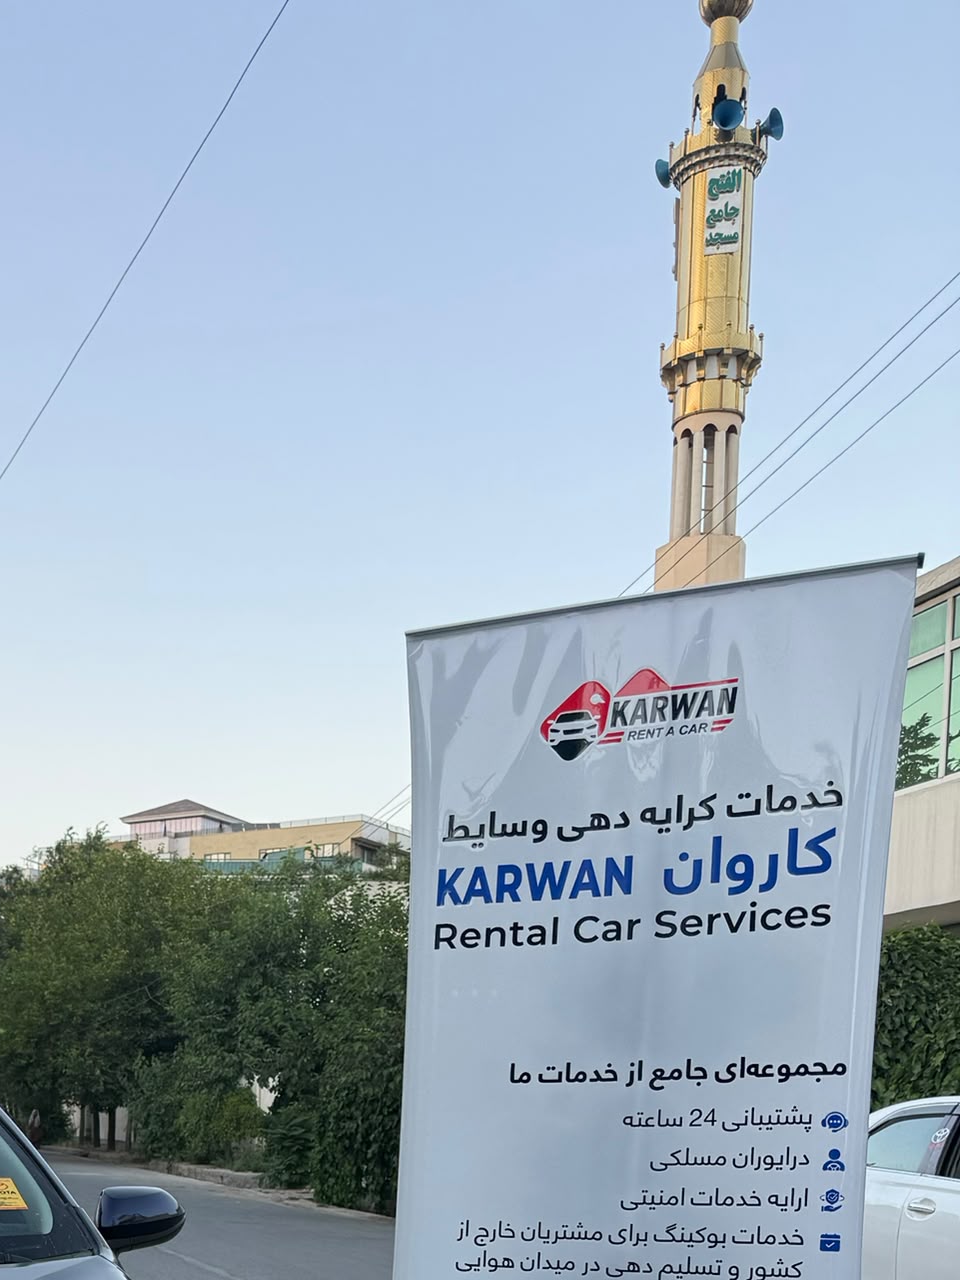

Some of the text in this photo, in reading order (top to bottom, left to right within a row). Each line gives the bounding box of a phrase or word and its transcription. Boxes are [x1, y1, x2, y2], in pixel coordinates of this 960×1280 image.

[707, 168, 742, 200] الفتح
[705, 201, 740, 228] جامع
[705, 230, 739, 250] مسجد
[610, 686, 738, 729] KARWAN
[627, 722, 709, 742] RENT A CAR
[442, 780, 844, 849] خدمات کرایه دهی وسایط
[663, 828, 837, 895] کاروان
[436, 855, 634, 906] KARWAN
[433, 902, 831, 951] Rental Car Services
[510, 1063, 532, 1085] ما
[538, 1062, 619, 1085] خدمات
[625, 1060, 643, 1087] از
[648, 1058, 708, 1091] جامع
[622, 1105, 812, 1133] پشتیبانی 24 ساعته
[649, 1147, 810, 1172] درایوران مسلکی
[620, 1187, 809, 1212] ارایه خدمات امنیتی
[456, 1219, 804, 1249] خدمات بوکینگ برای مشتریان خارج از
[455, 1250, 514, 1272] هوایی
[520, 1251, 575, 1275] میدان
[581, 1260, 601, 1276] در
[605, 1261, 653, 1278] دهی
[728, 1265, 740, 1280] و
